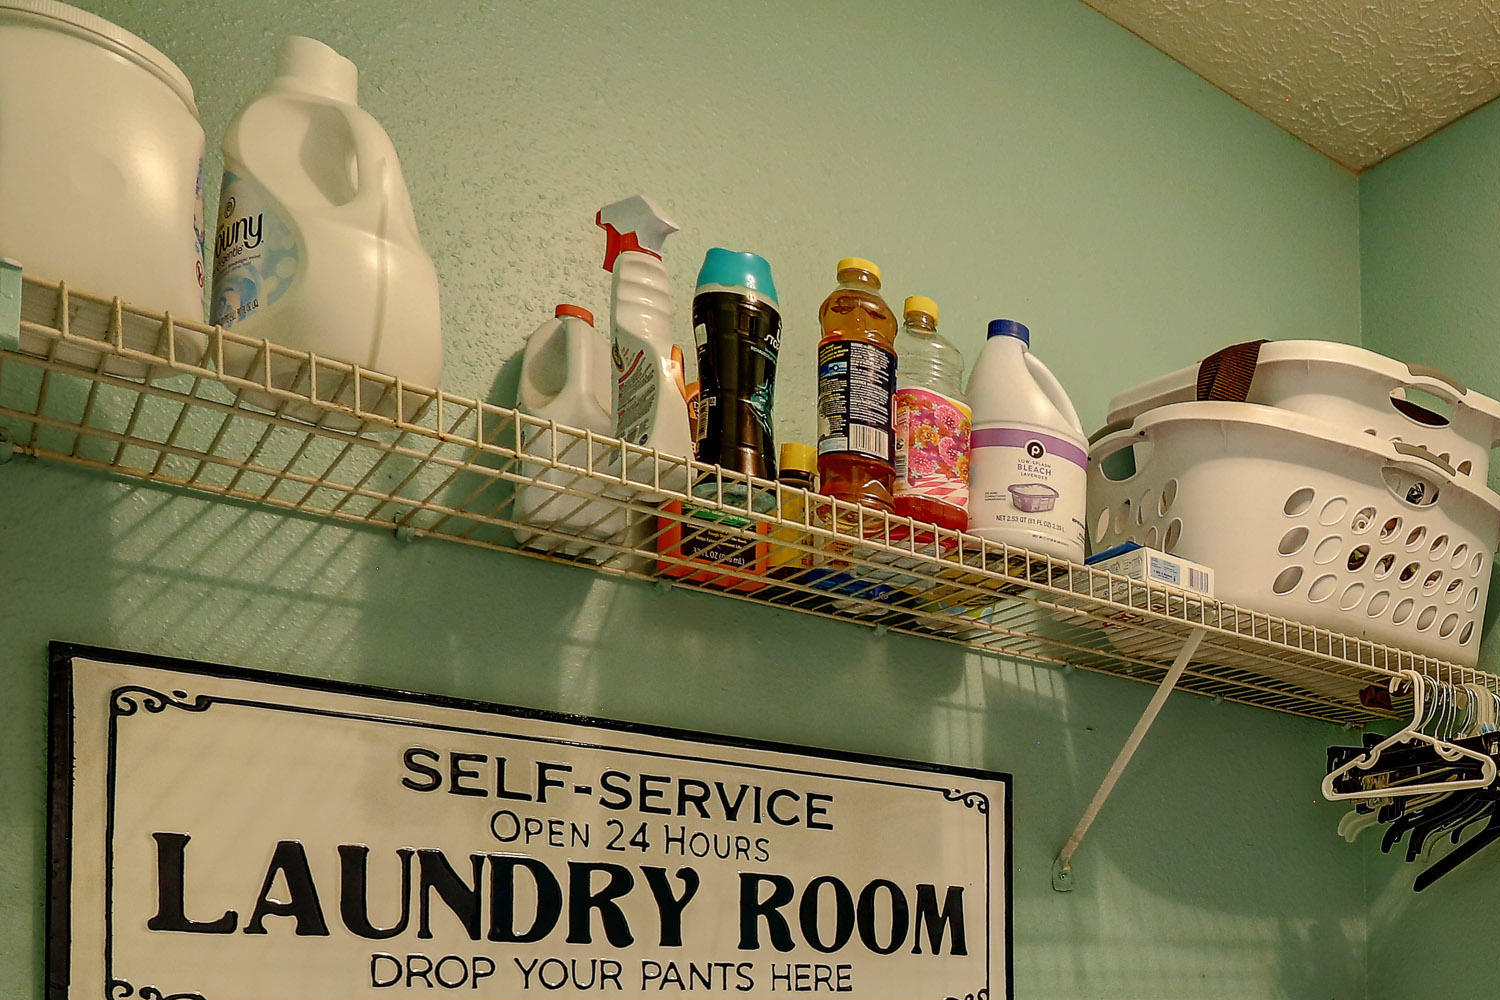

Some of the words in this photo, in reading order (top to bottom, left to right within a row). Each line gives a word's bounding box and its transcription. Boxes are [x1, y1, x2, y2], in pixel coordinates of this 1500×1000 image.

[1017, 463, 1052, 476] BLEACH
[1020, 472, 1048, 480] LAVENDER
[402, 747, 834, 831] SELF-SERVICE
[605, 819, 650, 853] 24
[146, 831, 700, 949] LAUNDRY
[737, 871, 968, 957] ROOM
[370, 952, 496, 990] DROP
[513, 956, 623, 992] YOUR
[640, 961, 755, 992] PANTS
[770, 963, 853, 992] HERE
